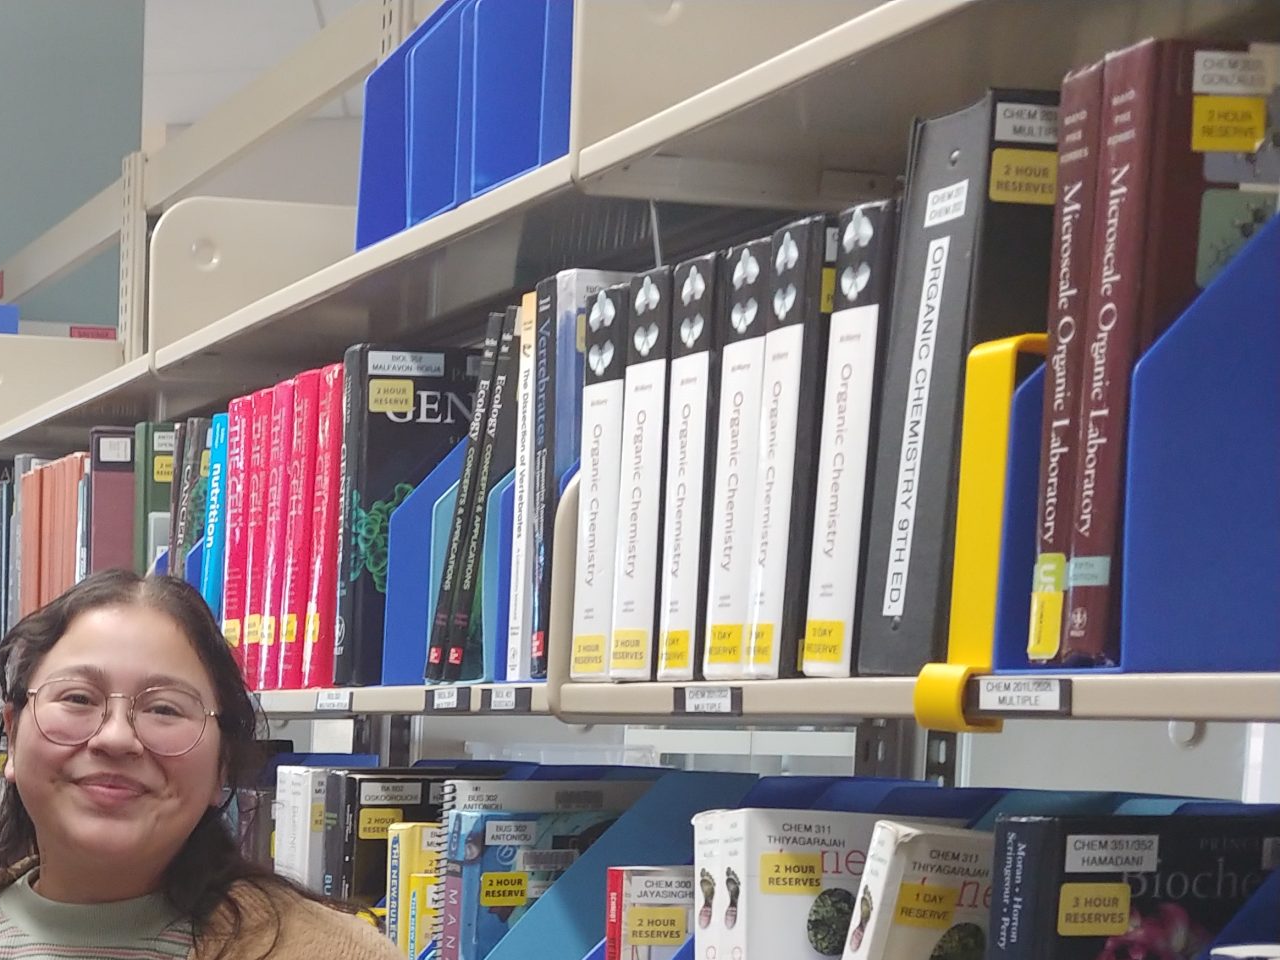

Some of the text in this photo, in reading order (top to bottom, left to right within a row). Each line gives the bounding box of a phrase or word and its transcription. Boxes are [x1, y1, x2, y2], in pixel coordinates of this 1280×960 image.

[1003, 108, 1038, 120] CHEM
[1202, 125, 1257, 138] RESERVE
[1219, 110, 1253, 120] HOUR
[996, 181, 1055, 194] RESERVES
[1015, 166, 1050, 177] HOUR
[1058, 180, 1084, 313] Microscale
[1100, 163, 1130, 297] Microscale
[1049, 316, 1076, 412] Organic
[1091, 302, 1117, 402] Organic
[373, 397, 409, 406] RESERVE
[383, 386, 407, 395] HOUR
[486, 375, 507, 438] Ecology
[536, 318, 552, 446] Vertebrates
[836, 363, 853, 446] Organic
[470, 379, 491, 442] Ecology
[519, 392, 531, 449] Dissection
[730, 391, 744, 467] Organic
[768, 381, 782, 459] Organic
[887, 245, 945, 611] ORGANIC CHEMISTRY 9TH ED.
[518, 453, 529, 467] of
[590, 424, 603, 492] Organic
[632, 410, 647, 480] Organic
[679, 404, 692, 477] Organic
[1042, 419, 1071, 544] Laboratory
[1076, 408, 1110, 538] Laboratory
[176, 465, 192, 546] CANCER
[205, 463, 222, 549] nutrition
[517, 470, 527, 539] Vertebrates
[671, 482, 687, 579] Chemistry
[721, 472, 739, 572] Chemistry
[757, 466, 776, 568] Chemistry
[823, 452, 845, 559] Chemistry
[443, 517, 463, 591] APPLICATIONS
[463, 515, 482, 590] APPLICATIONS
[584, 498, 600, 588] Chemistry
[625, 486, 642, 579] Chemistry
[621, 639, 641, 648] HOUR
[985, 681, 1011, 692] CHEM
[998, 695, 1040, 707] MULTIPLE
[490, 833, 532, 842] ANTONIOU
[513, 824, 528, 832] 302
[766, 835, 846, 848] THIYAGARAJAH
[782, 823, 832, 834] CHEM 311
[1073, 839, 1154, 851] CHEM 351/352
[389, 844, 400, 896] THE NEW
[488, 878, 524, 887] 2 HOUR
[768, 877, 821, 888] RESERVES
[774, 865, 816, 875] 2 HOUR
[911, 861, 990, 878] THIYAGARAJAH
[929, 850, 980, 864] CHEM 311
[1081, 856, 1144, 867] HAMADANI
[485, 889, 525, 898] RESERVE
[644, 880, 692, 889] CHEM 300
[923, 893, 945, 904] DAY
[997, 831, 1017, 950] Scrimgeour Perry
[1011, 842, 1027, 943] Moran Horton
[1084, 897, 1120, 908] HOUR
[631, 930, 681, 939] RESERVES
[637, 918, 676, 927] 2 HOUR
[900, 907, 950, 921] RESERVE
[1065, 912, 1125, 924] RESERVES
